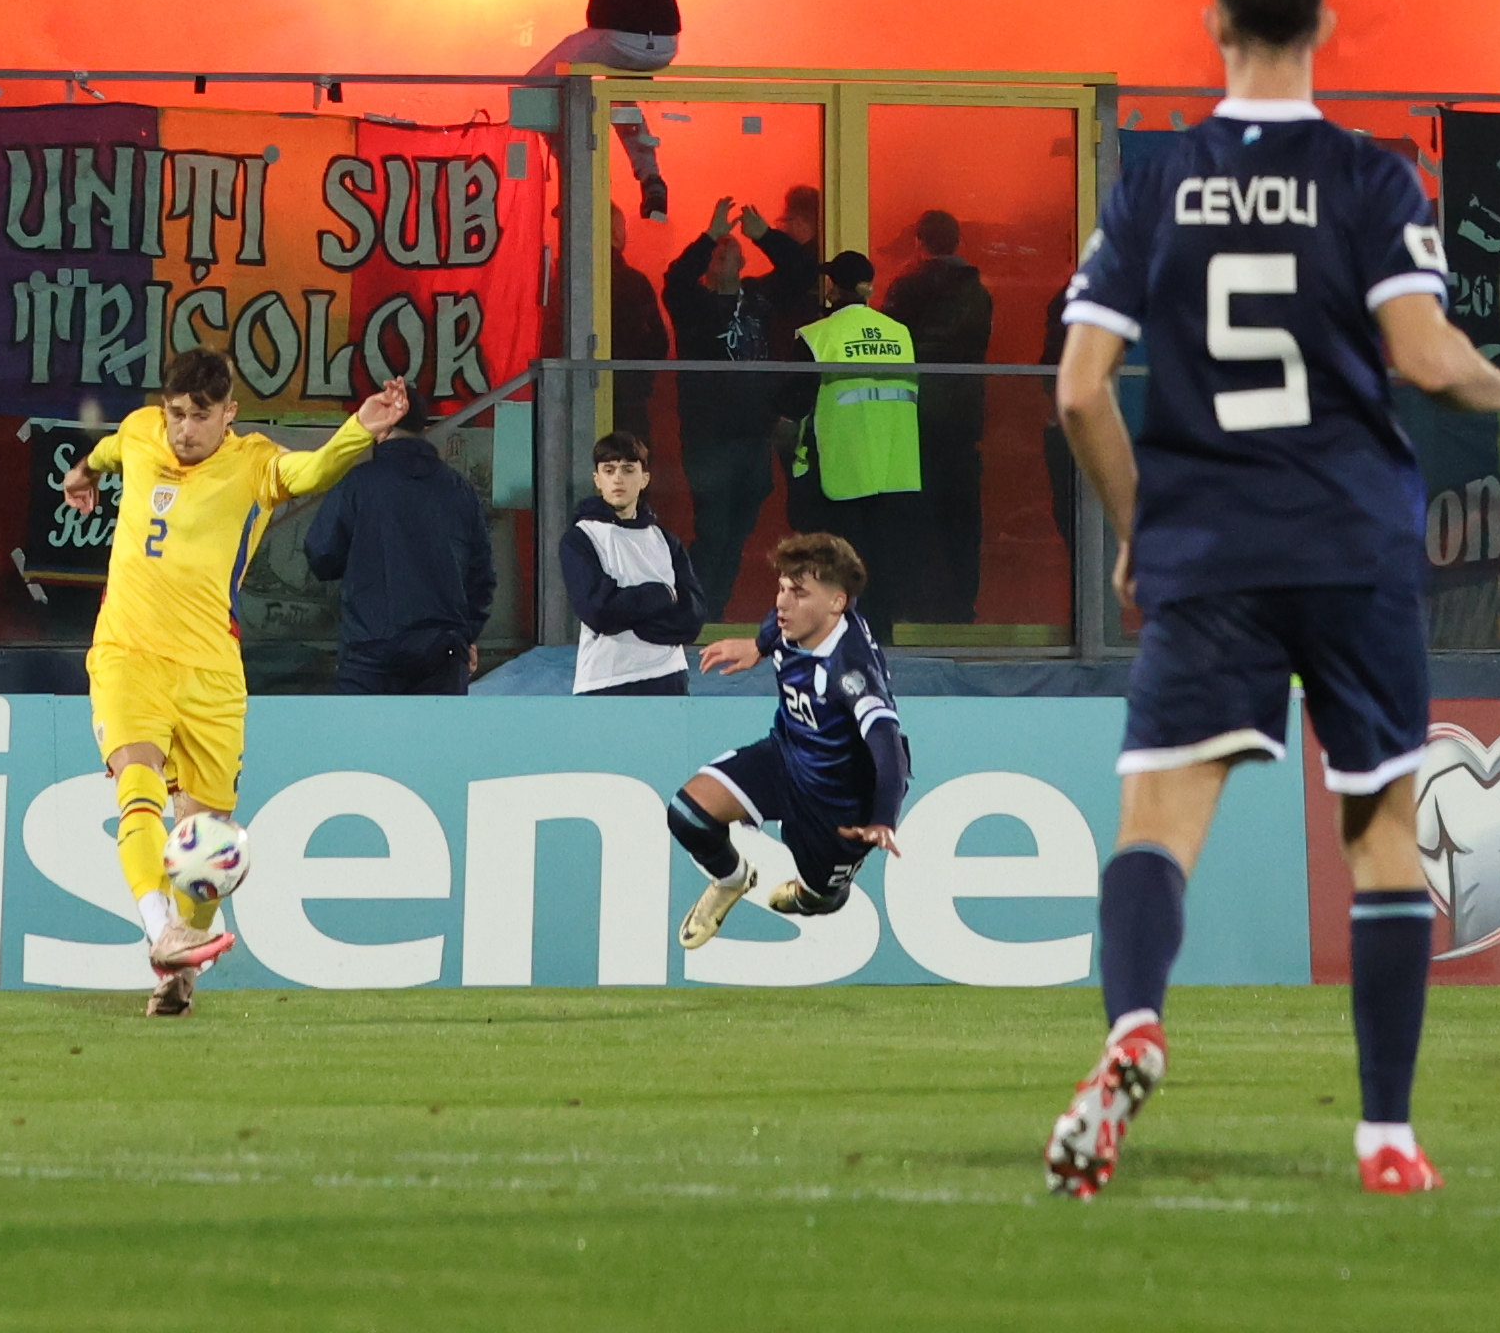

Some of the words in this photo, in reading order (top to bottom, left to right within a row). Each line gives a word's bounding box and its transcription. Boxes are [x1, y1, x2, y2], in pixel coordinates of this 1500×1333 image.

[317, 154, 502, 273] SUB
[1175, 175, 1319, 227] CEVOLI
[844, 342, 902, 360] STEWARD
[1206, 251, 1312, 432] 5
[145, 518, 168, 558] 2
[782, 682, 819, 731] 20
